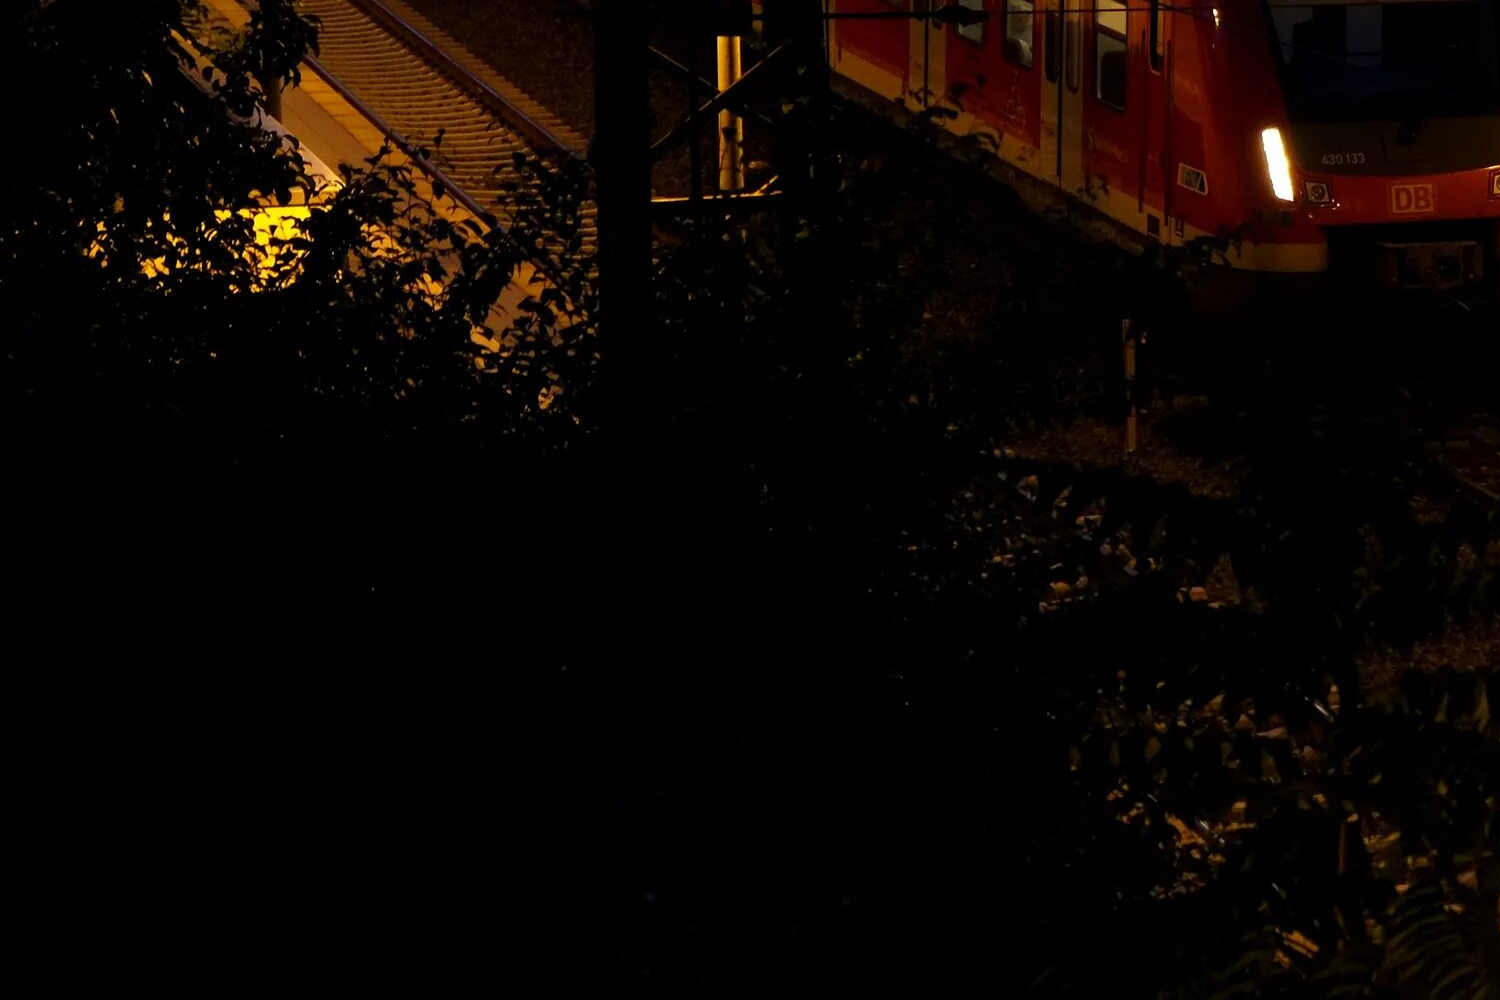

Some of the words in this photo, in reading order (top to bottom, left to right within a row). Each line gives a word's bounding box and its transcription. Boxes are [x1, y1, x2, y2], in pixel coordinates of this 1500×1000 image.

[1321, 153, 1343, 165] 430
[1346, 152, 1366, 164] 133
[1393, 185, 1431, 211] DB
